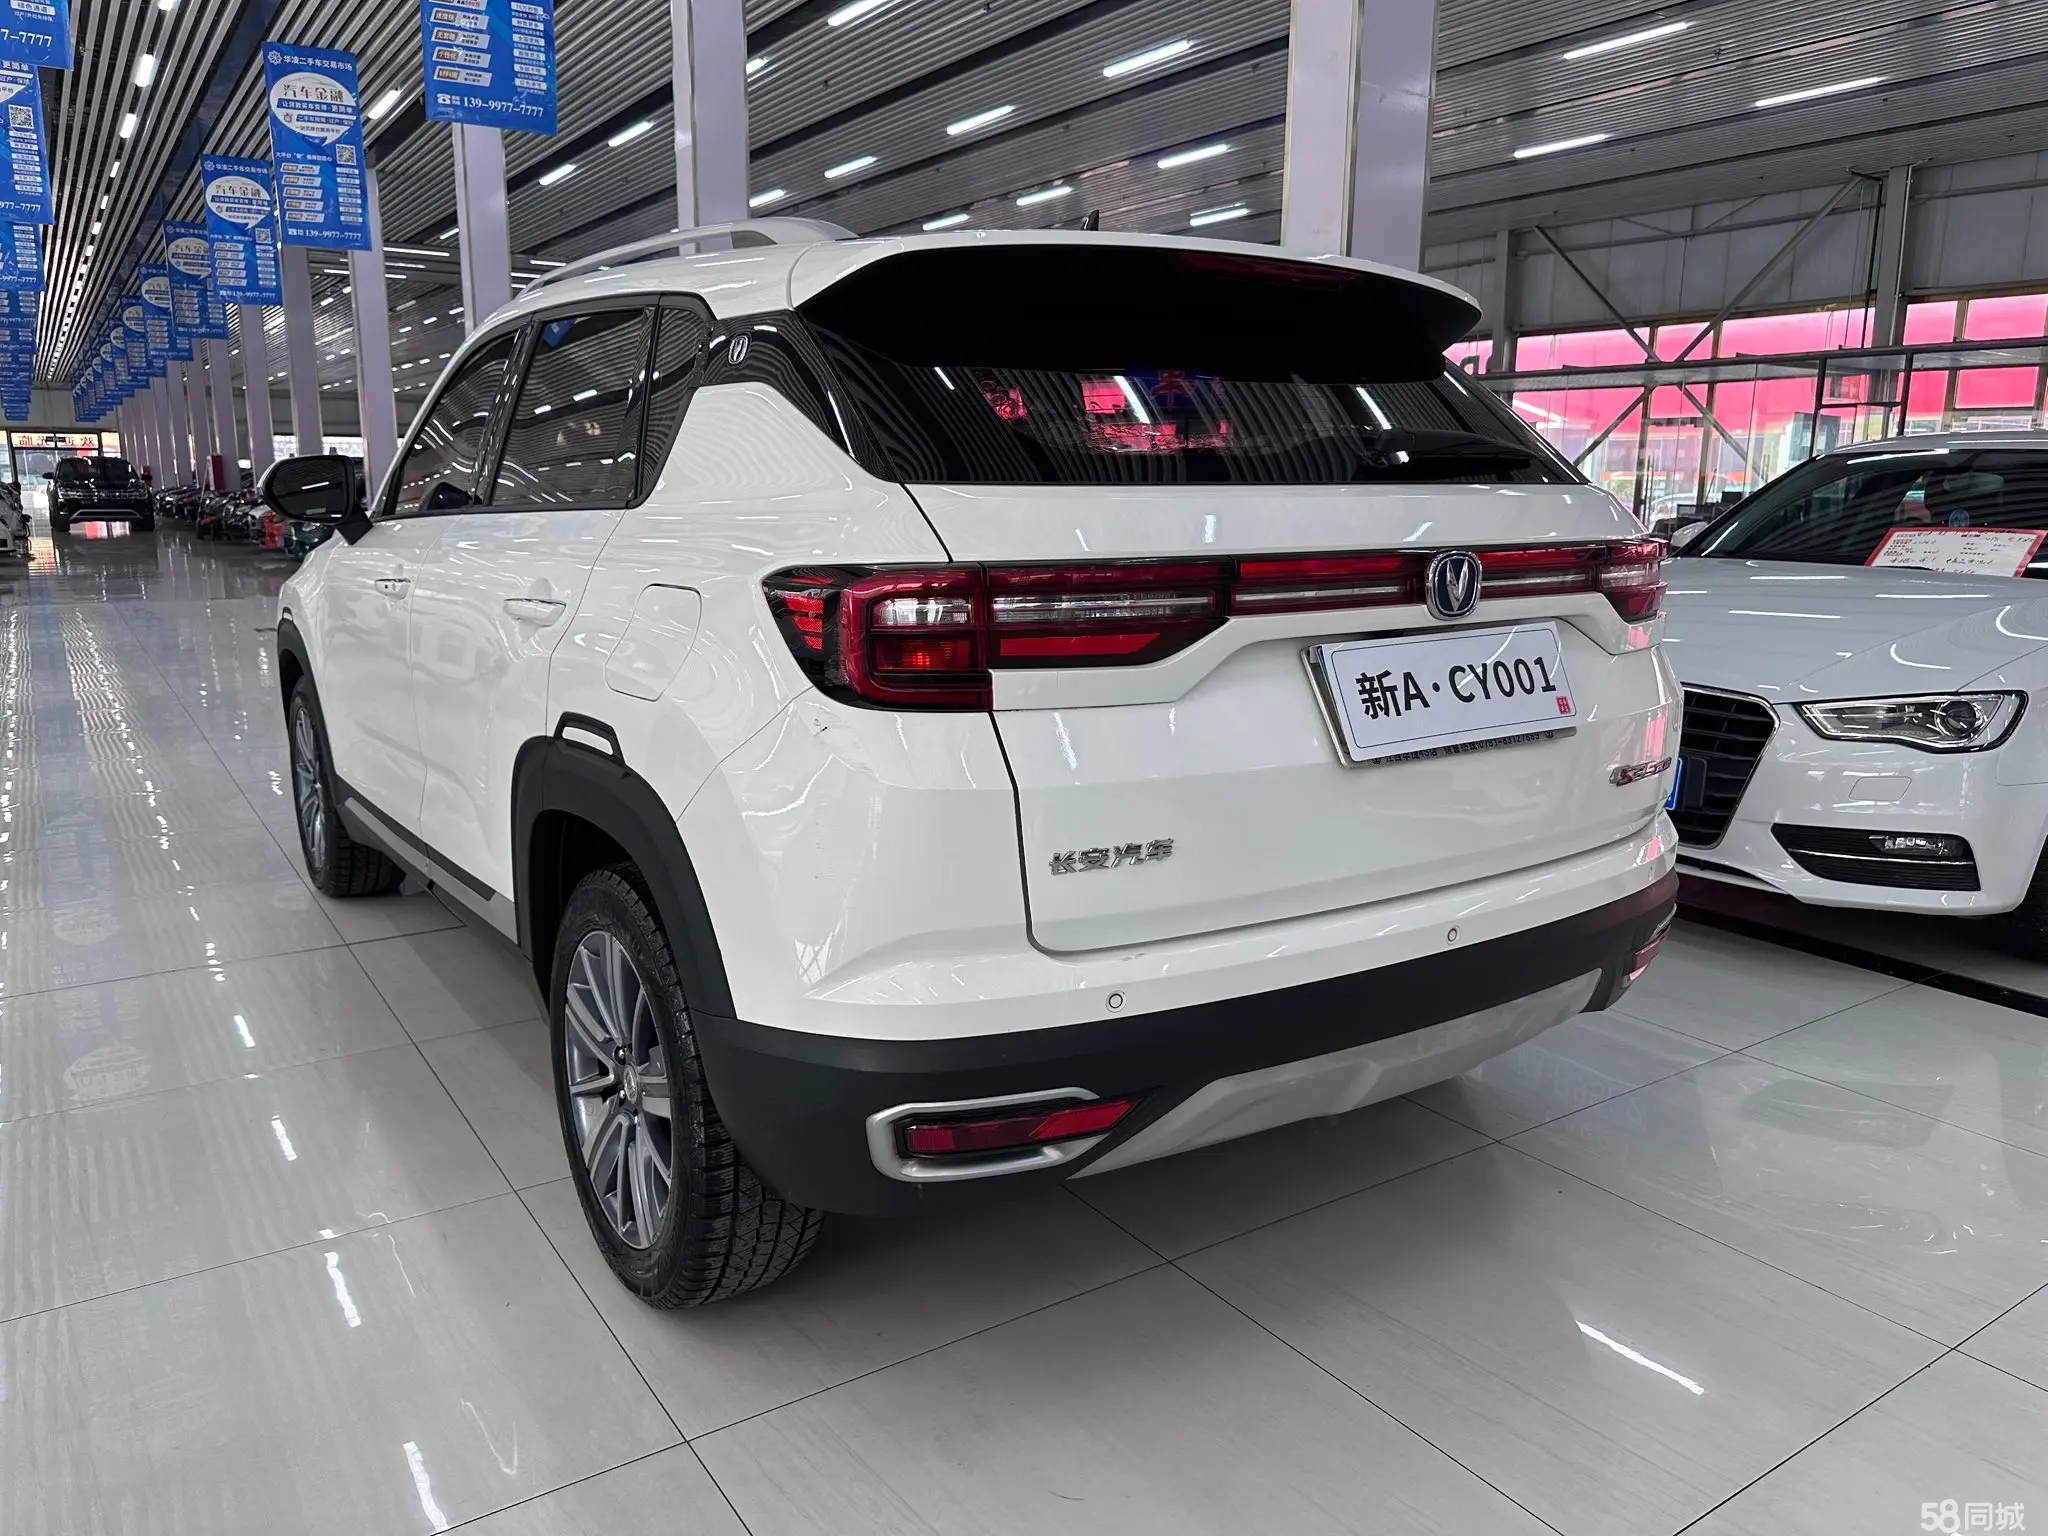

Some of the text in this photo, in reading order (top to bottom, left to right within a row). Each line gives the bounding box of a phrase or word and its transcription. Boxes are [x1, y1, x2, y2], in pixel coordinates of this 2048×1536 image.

[0, 28, 52, 48] 7-7777
[283, 54, 353, 72] 华凌二手车交易市场
[283, 83, 345, 104] 汽车金融
[463, 96, 544, 118] 139-9977-7777
[305, 229, 361, 240] 139-9977-7777
[1048, 838, 1175, 876] 长安汽车
